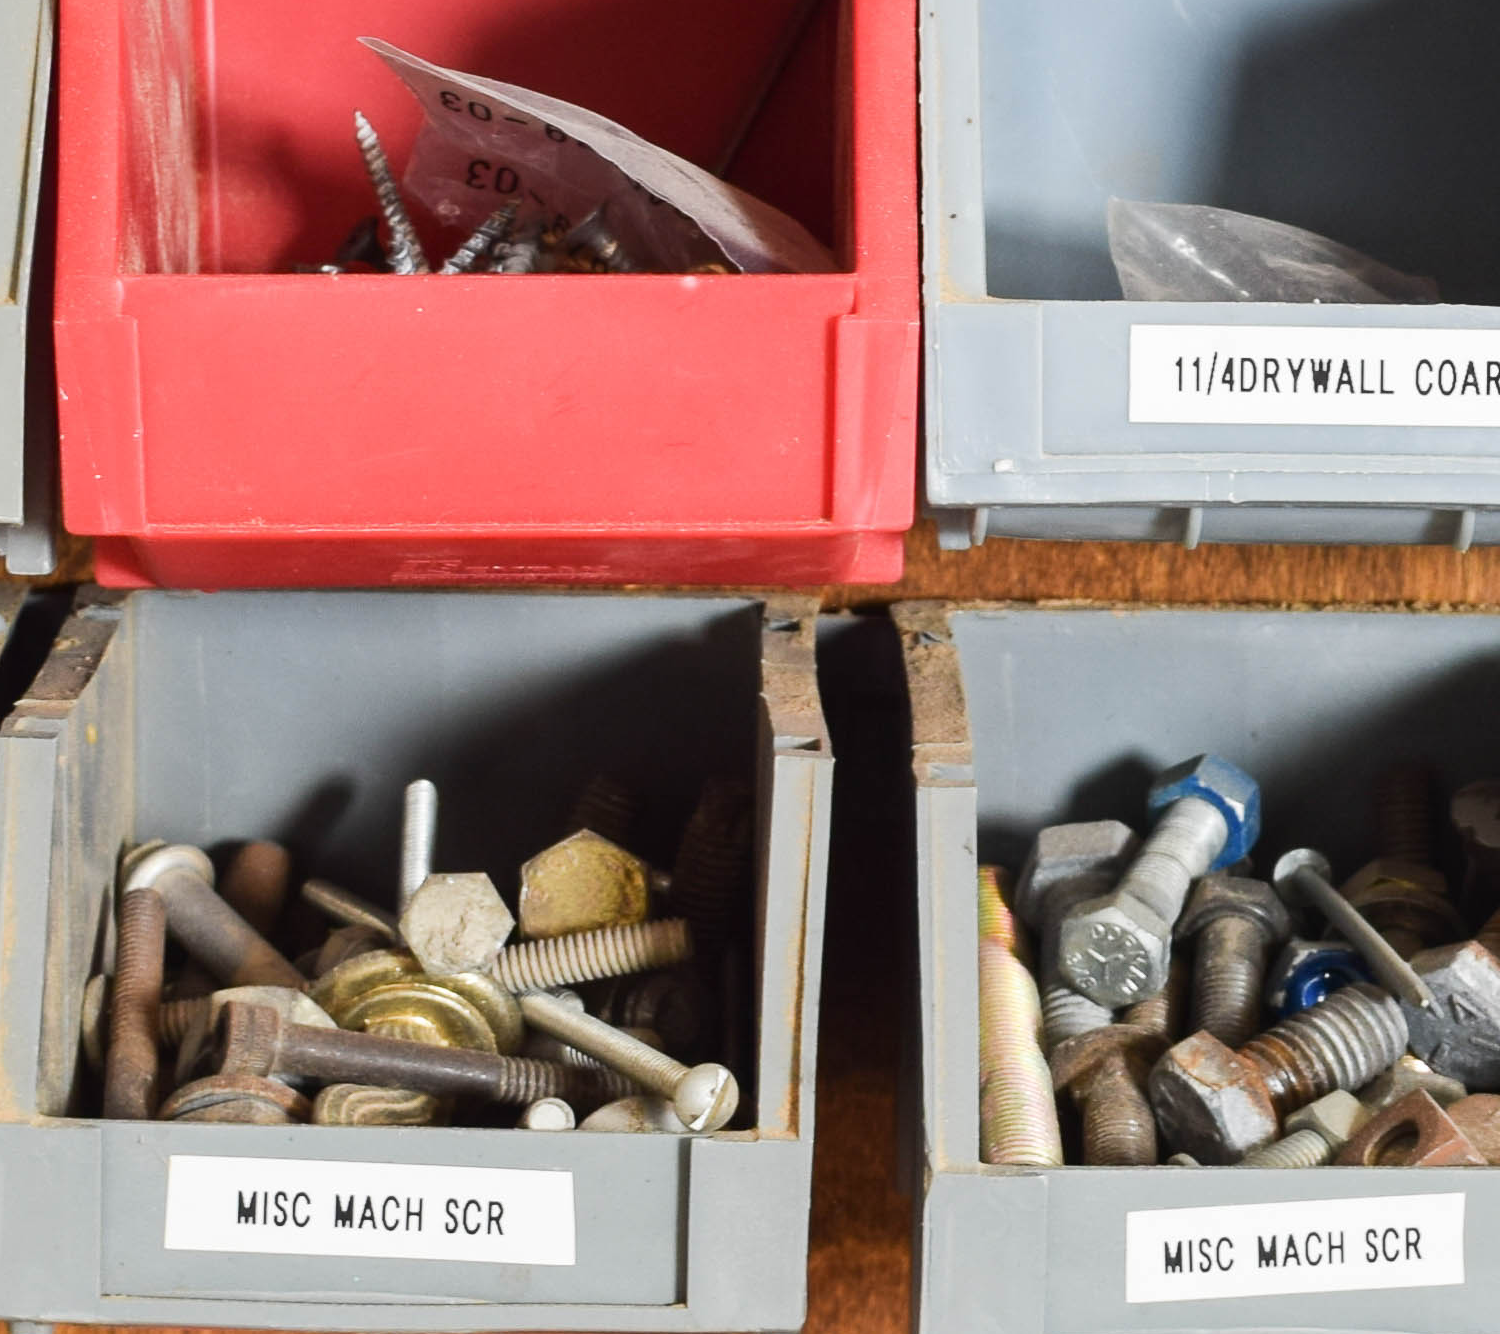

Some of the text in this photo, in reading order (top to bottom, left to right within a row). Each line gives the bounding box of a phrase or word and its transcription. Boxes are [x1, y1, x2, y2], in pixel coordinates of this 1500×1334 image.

[237, 1190, 504, 1236] MISC MACH SCR
[1164, 1227, 1422, 1275] MISC MACH SCR
